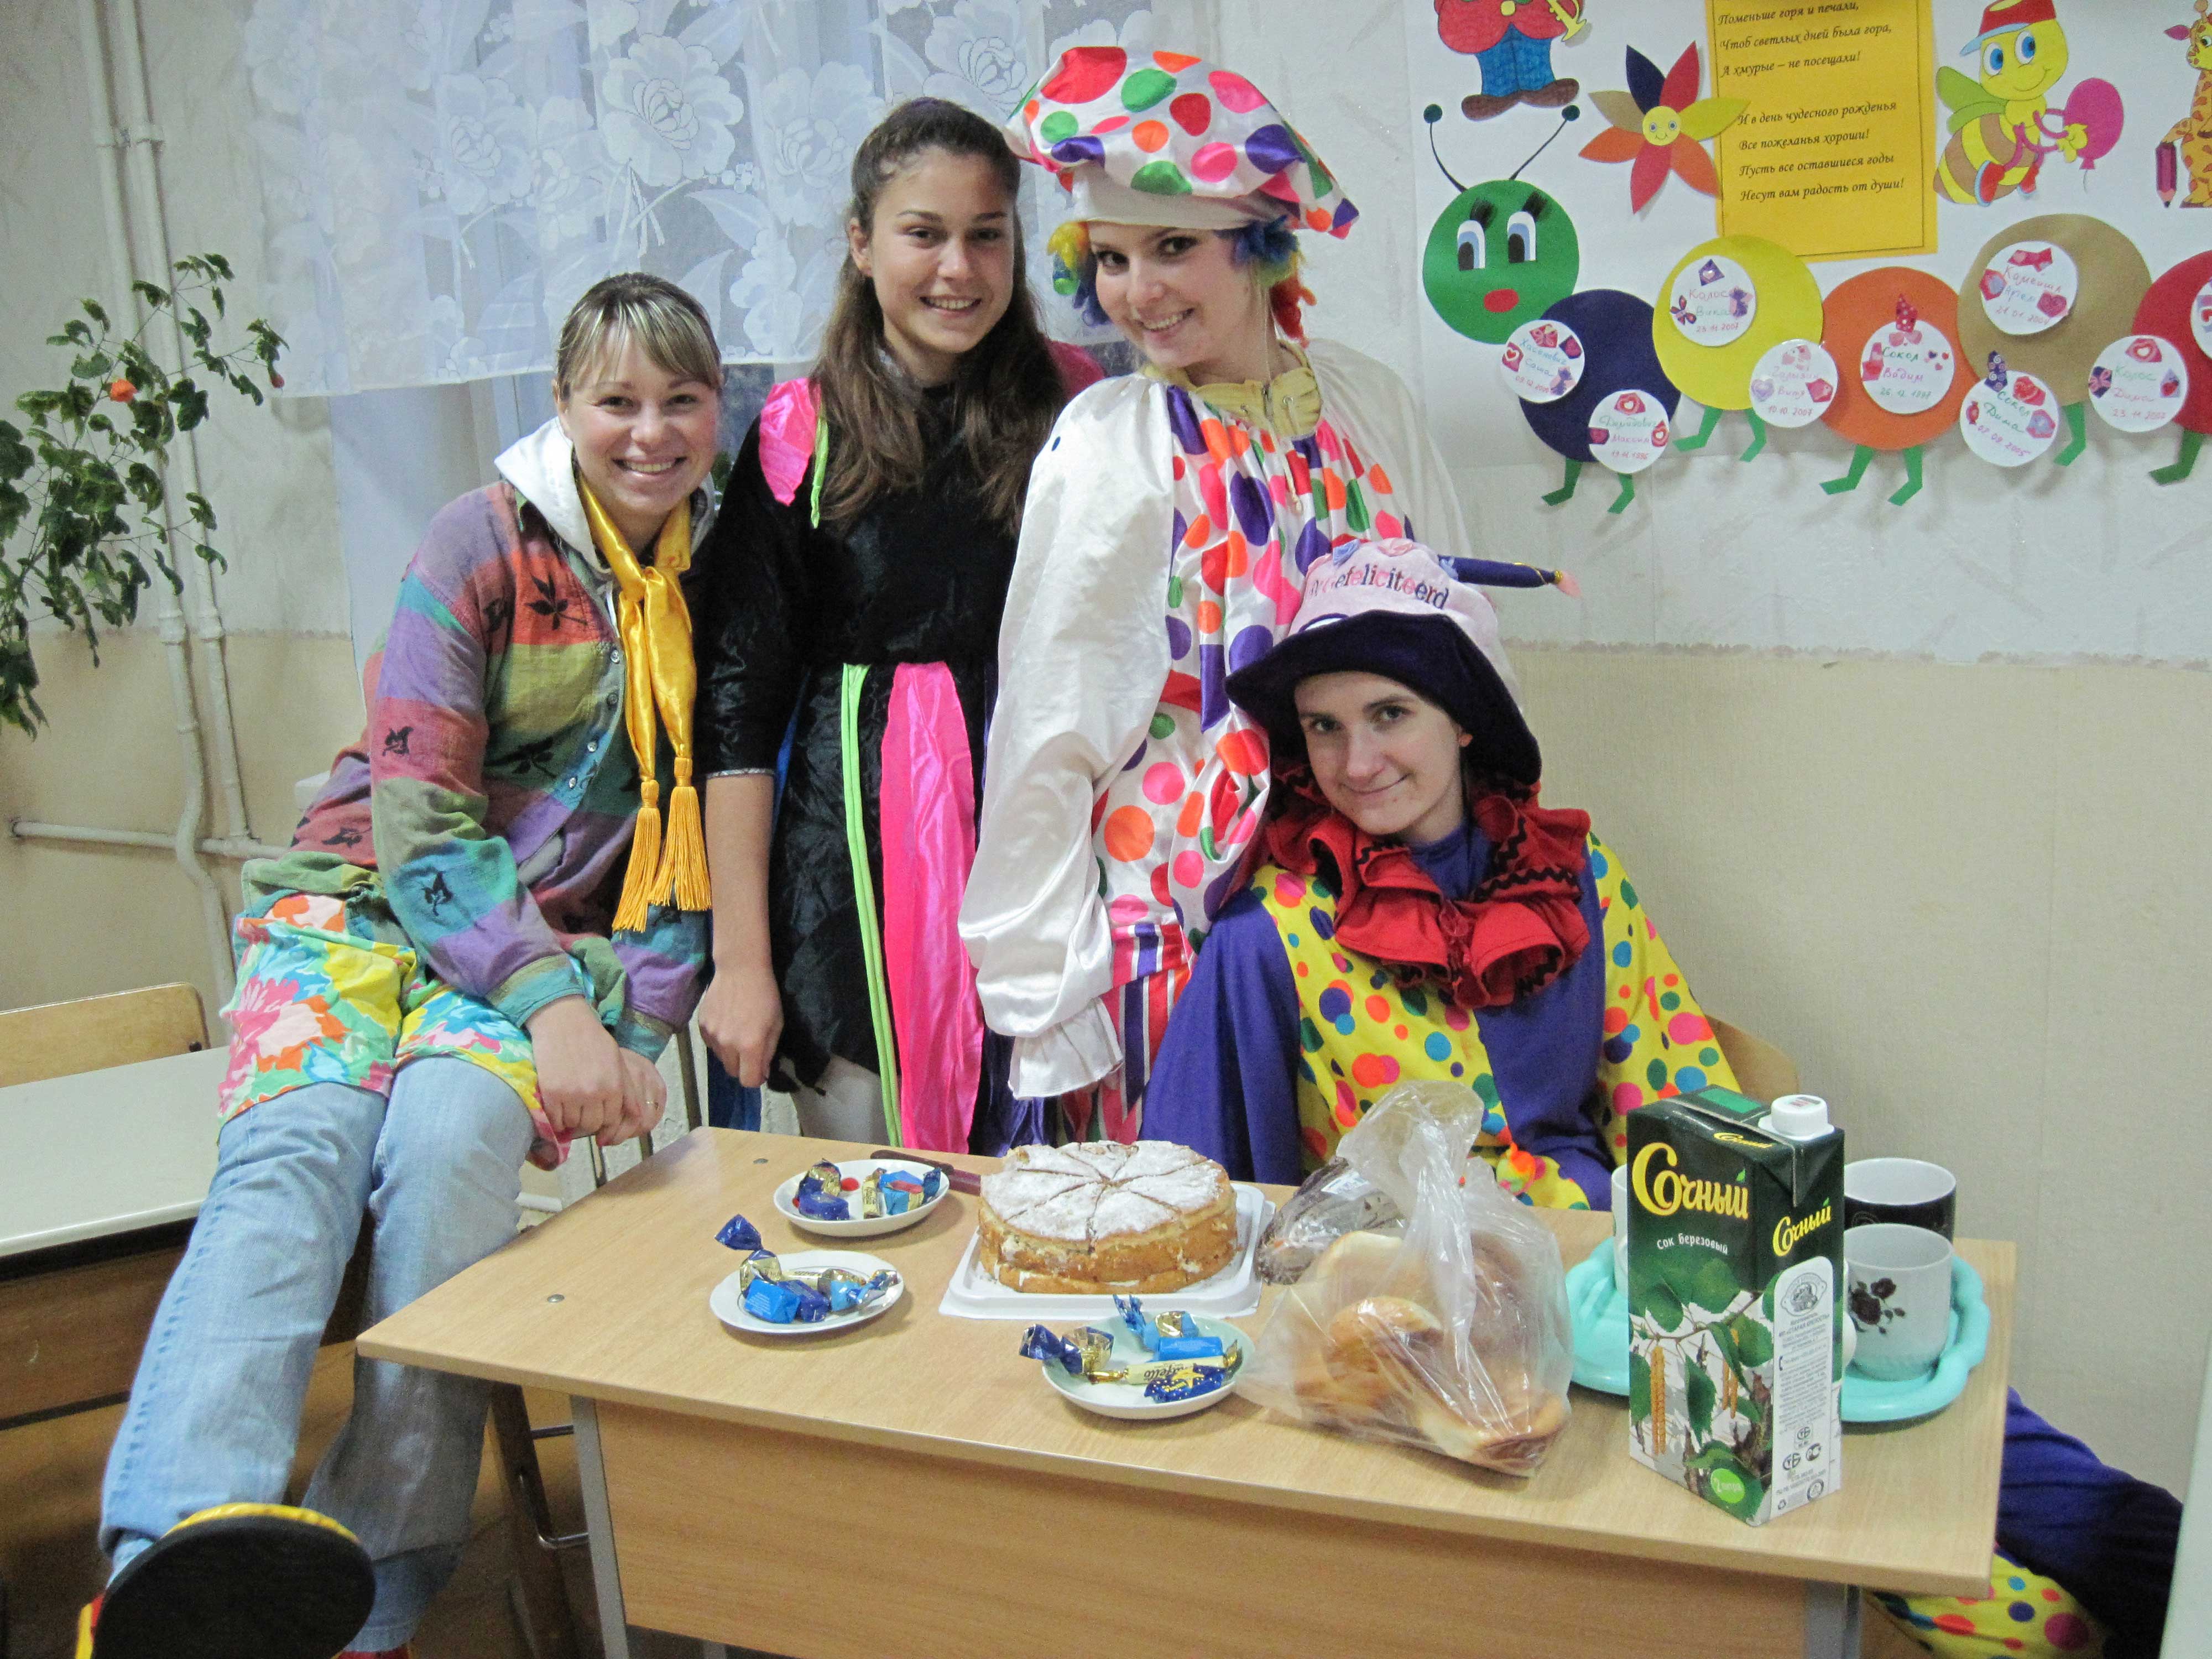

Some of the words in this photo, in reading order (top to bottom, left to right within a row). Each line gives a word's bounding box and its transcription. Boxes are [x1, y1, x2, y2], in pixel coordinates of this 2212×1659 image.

[1718, 10, 1775, 25] Поменьше
[1779, 9, 1803, 20] горя
[1818, 2, 1859, 13] печали,
[1720, 36, 1751, 50] Чтоб
[1754, 34, 1801, 46] светлых
[1803, 28, 1828, 41] дней
[1832, 26, 1860, 38] была
[1864, 24, 1891, 36] гора,
[1721, 65, 1729, 77] А
[1734, 61, 1775, 76] хмурые
[1788, 60, 1799, 68] не
[1804, 51, 1861, 66] посещали!
[1738, 114, 1750, 126] И
[1760, 112, 1782, 123] день
[1786, 108, 1838, 123] чудесного
[1841, 101, 1897, 118] рожденья
[1739, 140, 1757, 150] Все
[1761, 135, 1820, 149] пожеланья
[1824, 128, 1869, 145] хороши!
[1739, 164, 1775, 179] Пусть
[1778, 164, 1794, 172] все
[1797, 157, 1864, 171] оставшиеся
[1867, 152, 1894, 164] годы
[1740, 190, 1775, 203] Несут
[1779, 189, 1799, 198] вам
[1803, 183, 1849, 199] радость
[1852, 183, 1867, 191] от
[1871, 177, 1904, 193] души!
[1882, 346, 1919, 362] Сокол
[1883, 367, 1923, 384] Вадим
[1632, 1142, 1749, 1220] Сочный
[1772, 1198, 1832, 1256] Сочный
[1657, 1238, 1674, 1250] Сок
[1678, 1233, 1729, 1255] березовый
